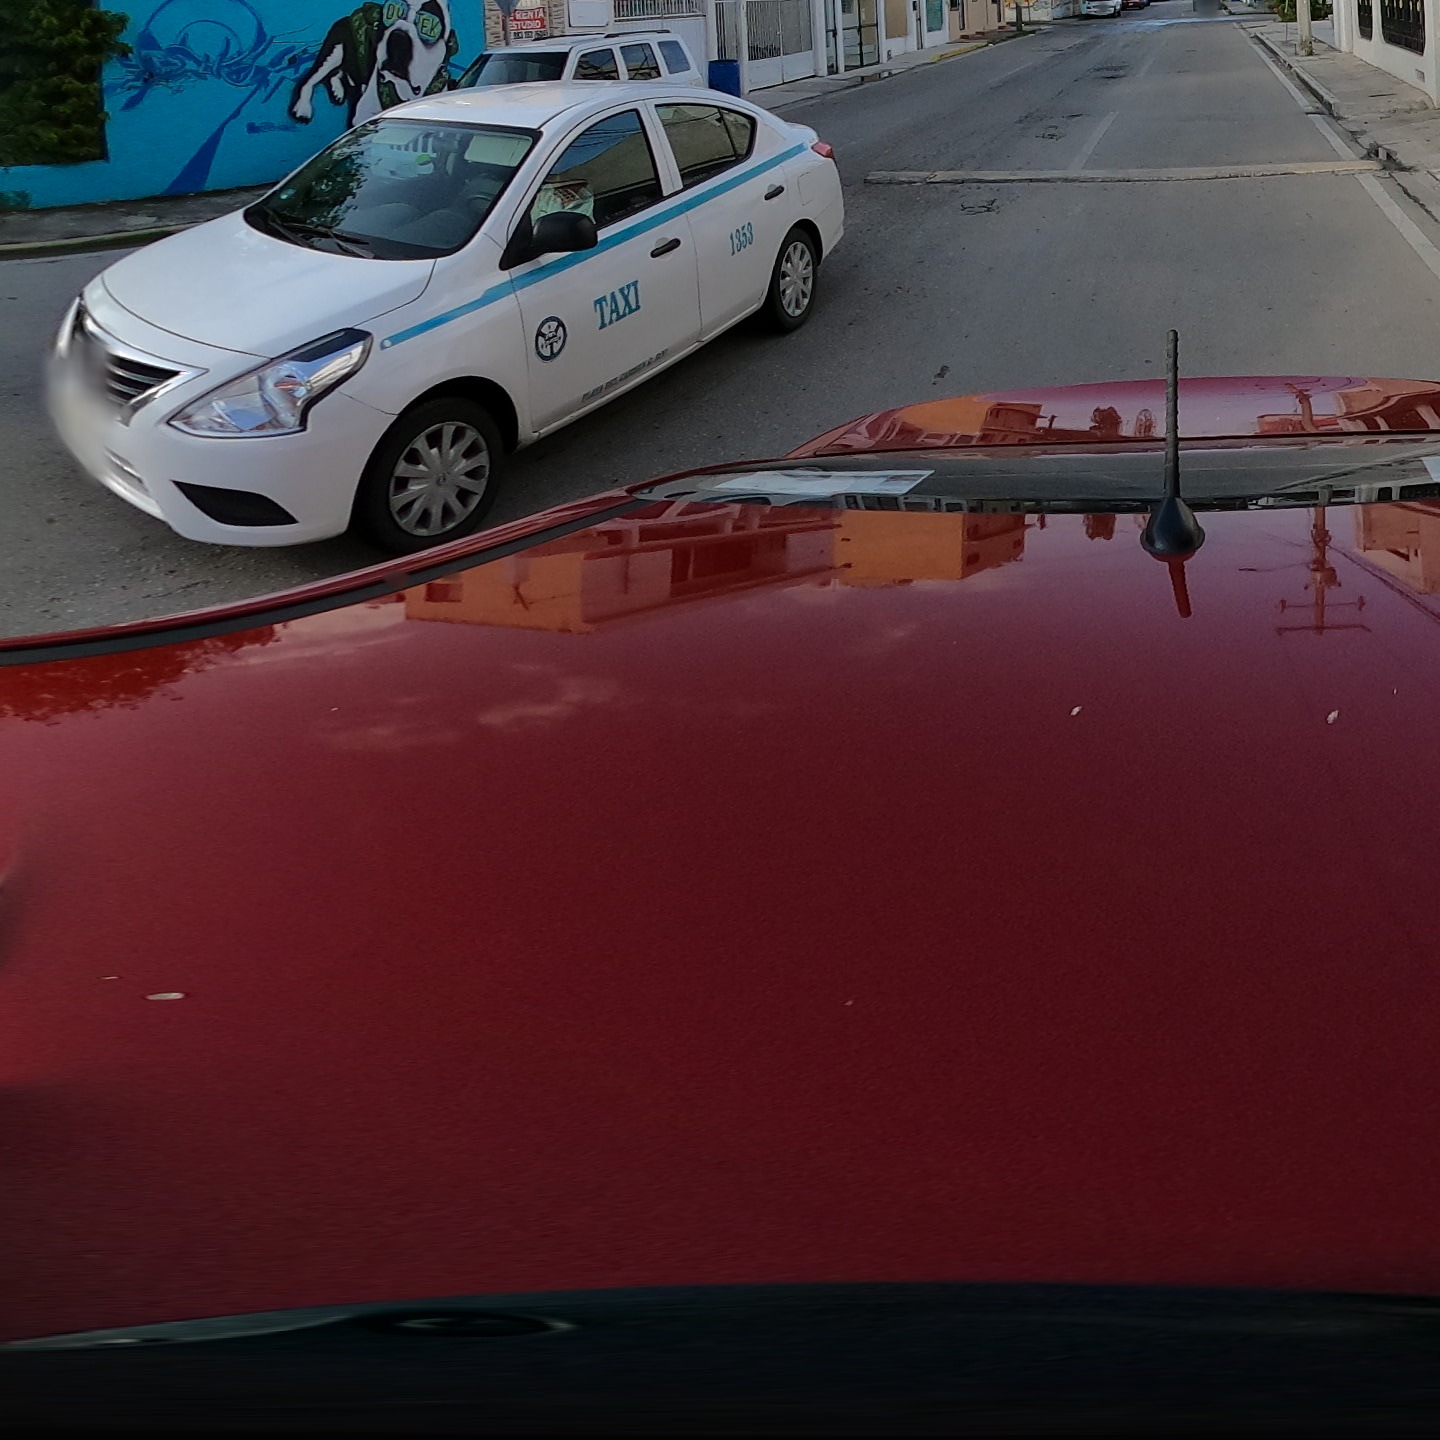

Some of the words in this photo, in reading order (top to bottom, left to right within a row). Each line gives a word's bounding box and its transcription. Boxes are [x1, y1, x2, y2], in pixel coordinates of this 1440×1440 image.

[515, 7, 545, 20] RENTA
[729, 221, 754, 256] 1353
[593, 279, 642, 331] TAXI
